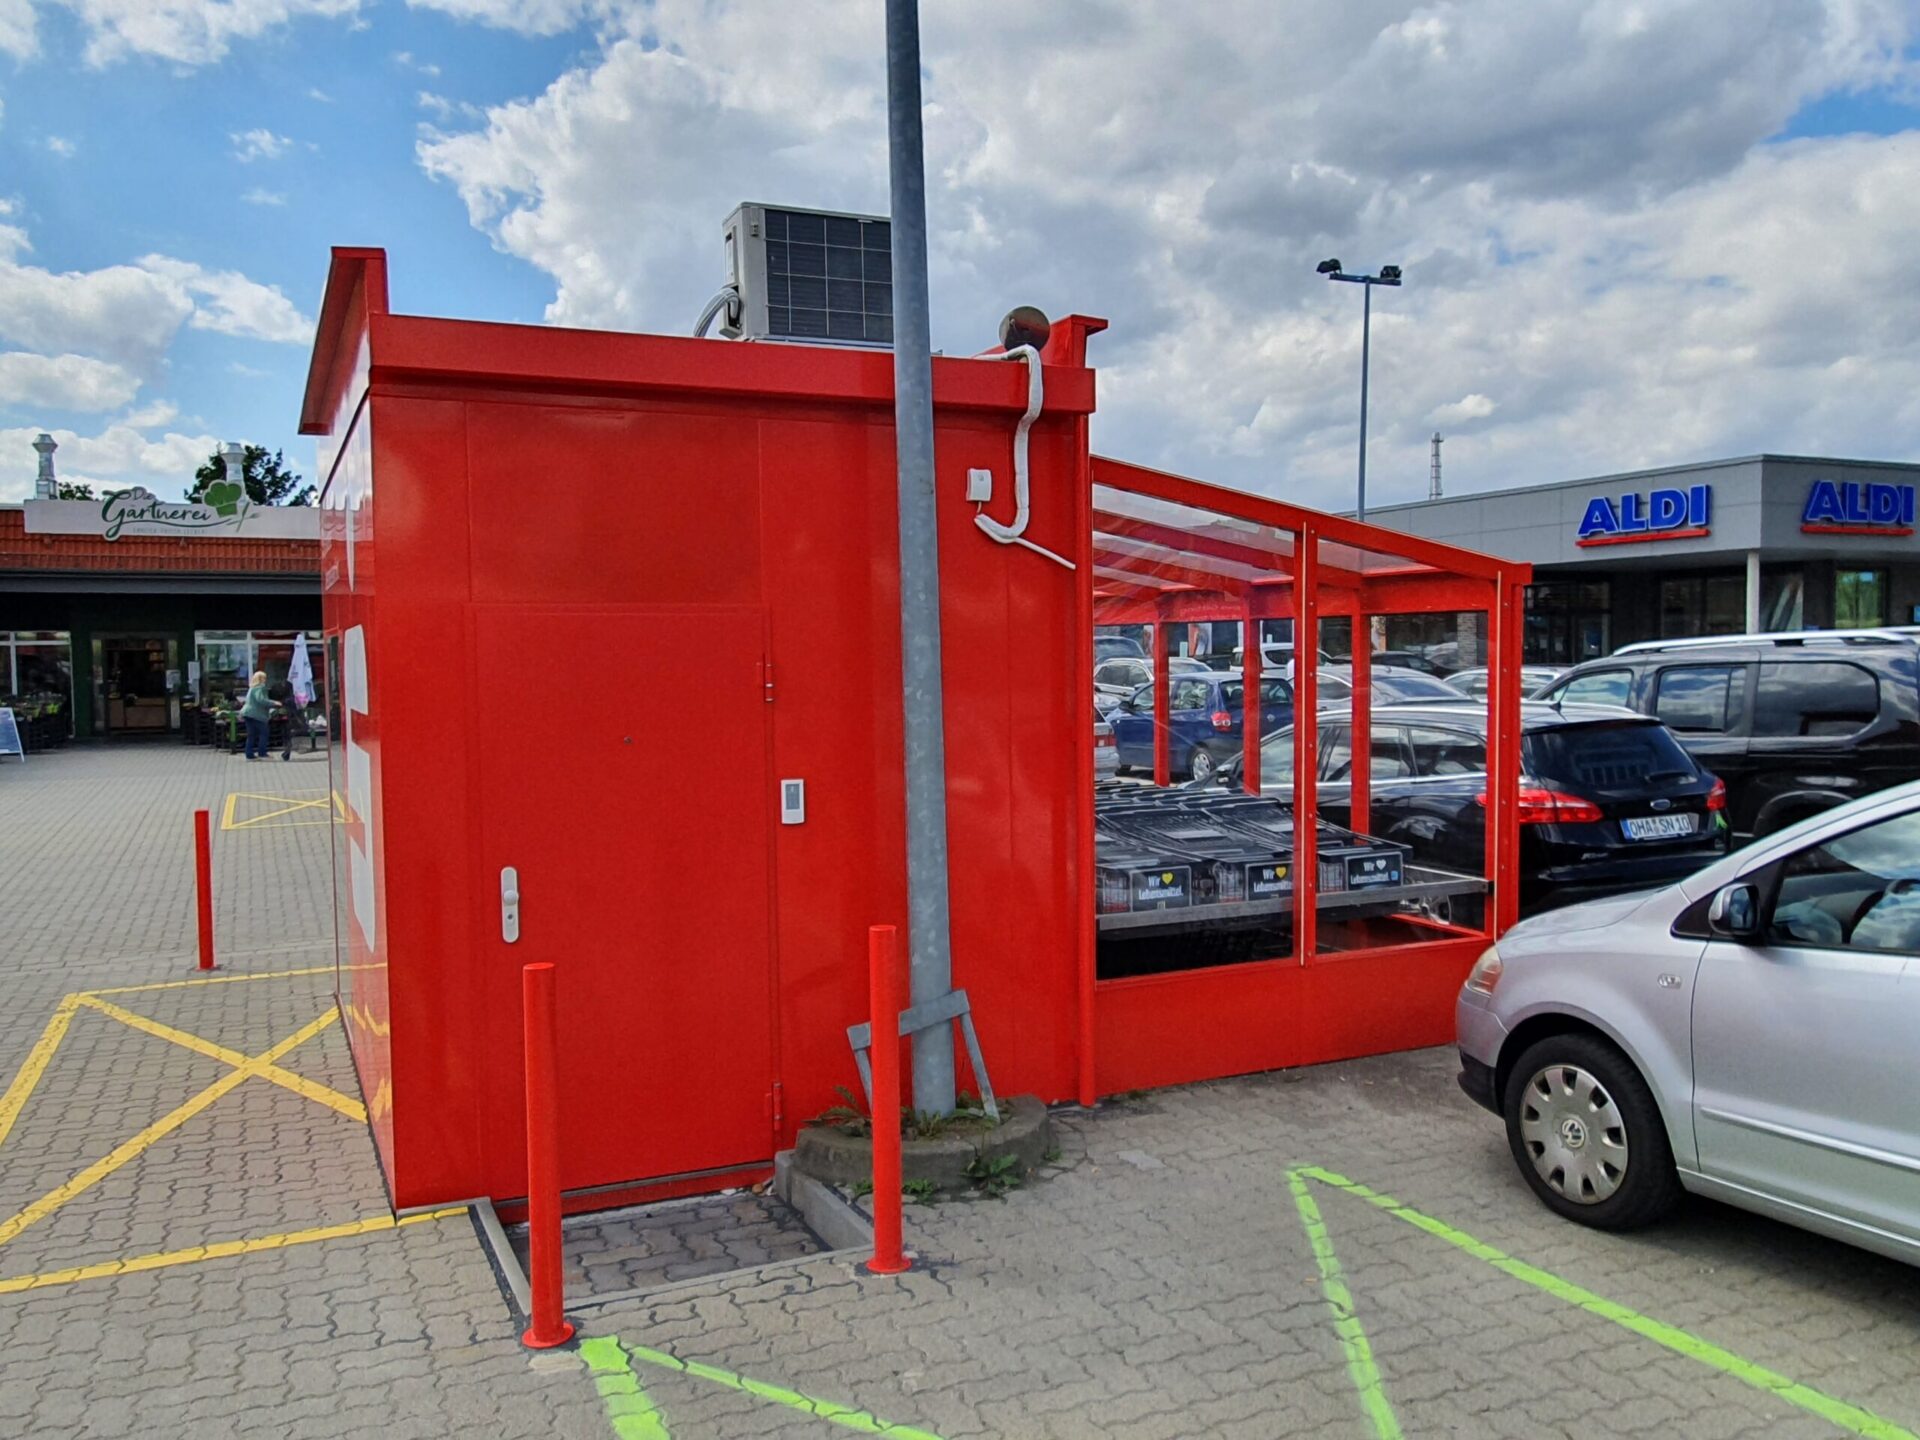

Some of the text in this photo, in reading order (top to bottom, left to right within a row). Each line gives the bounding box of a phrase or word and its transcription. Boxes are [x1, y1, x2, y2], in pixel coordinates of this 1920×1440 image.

[133, 489, 154, 501] Die
[1803, 480, 1915, 525] ALDI
[101, 490, 212, 539] Gärtnerei
[1577, 484, 1710, 537] ALDI
[1629, 815, 1690, 836] OHA SN 10
[1148, 875, 1161, 887] Wir
[1263, 868, 1275, 880] Wir
